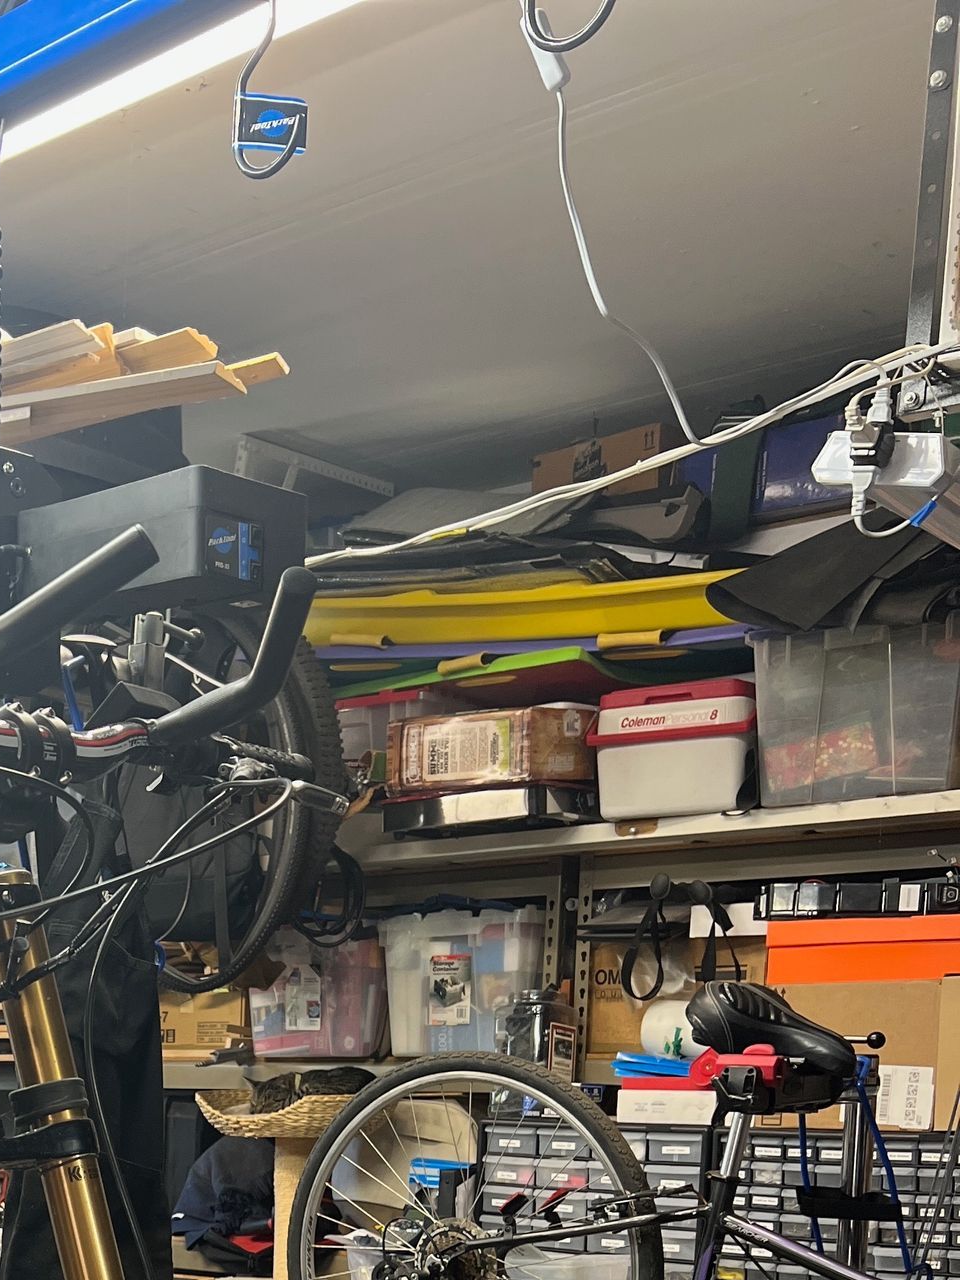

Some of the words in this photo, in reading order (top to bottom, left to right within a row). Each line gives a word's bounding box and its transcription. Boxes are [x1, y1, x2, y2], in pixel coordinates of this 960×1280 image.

[620, 715, 666, 729] Coleman
[709, 708, 719, 721] 8
[432, 960, 455, 969] Storage
[724, 1220, 769, 1244] SEARCHER
